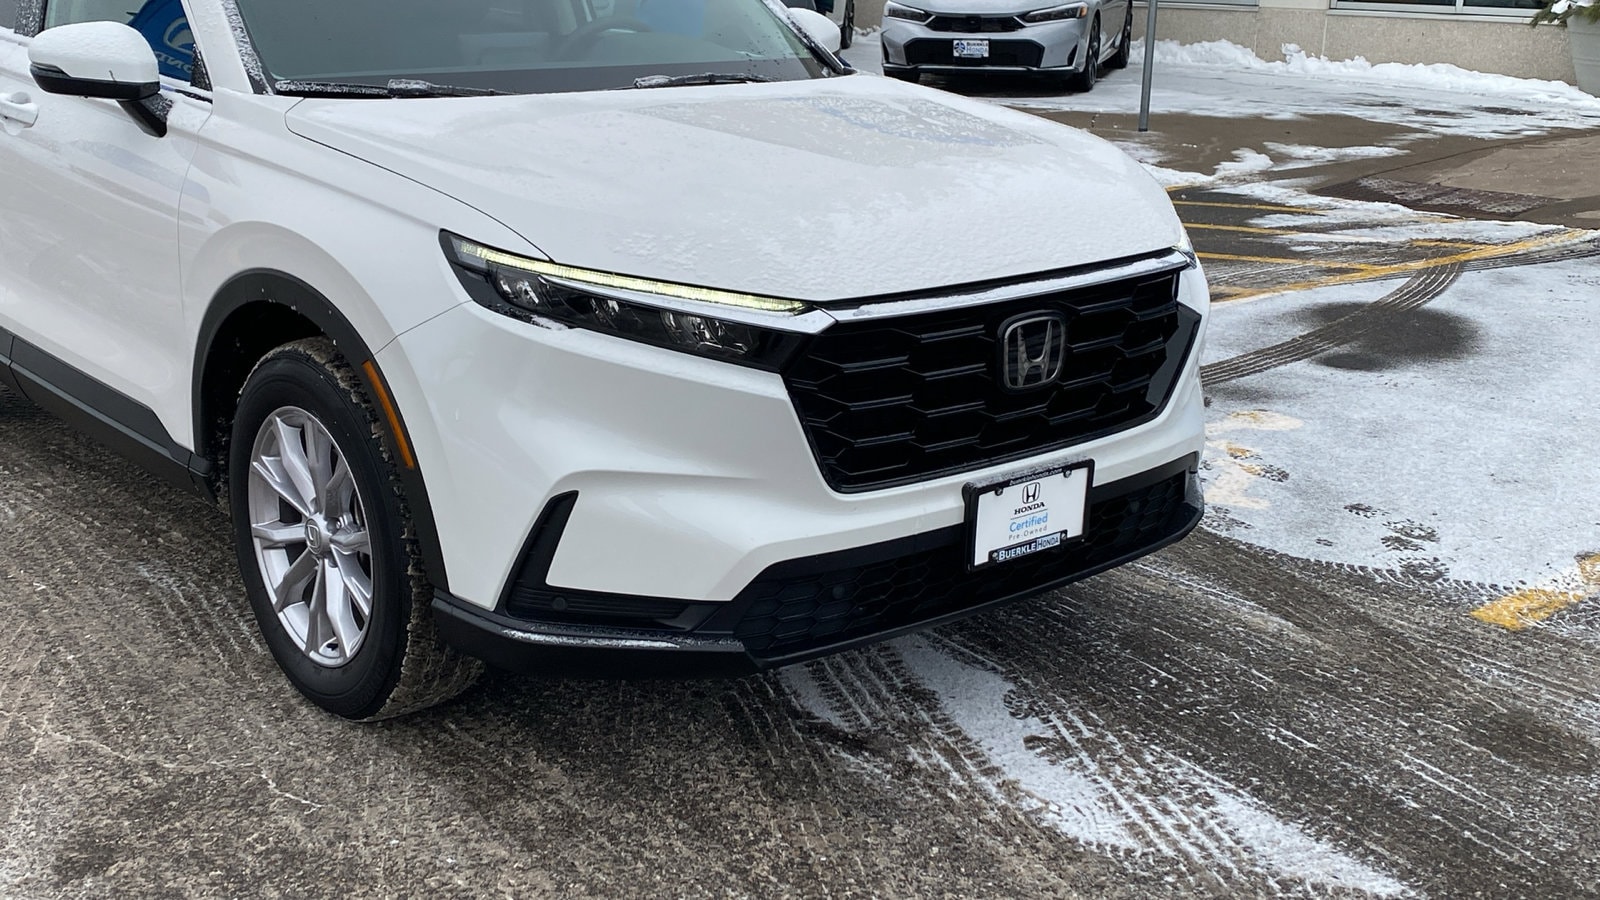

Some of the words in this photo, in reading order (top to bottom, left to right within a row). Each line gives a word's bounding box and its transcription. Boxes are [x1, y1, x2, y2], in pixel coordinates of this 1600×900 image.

[1014, 502, 1045, 515] HONDA
[1010, 513, 1048, 532] Certified
[998, 543, 1036, 560] BUERKLE
[1037, 537, 1059, 550] HONDA
